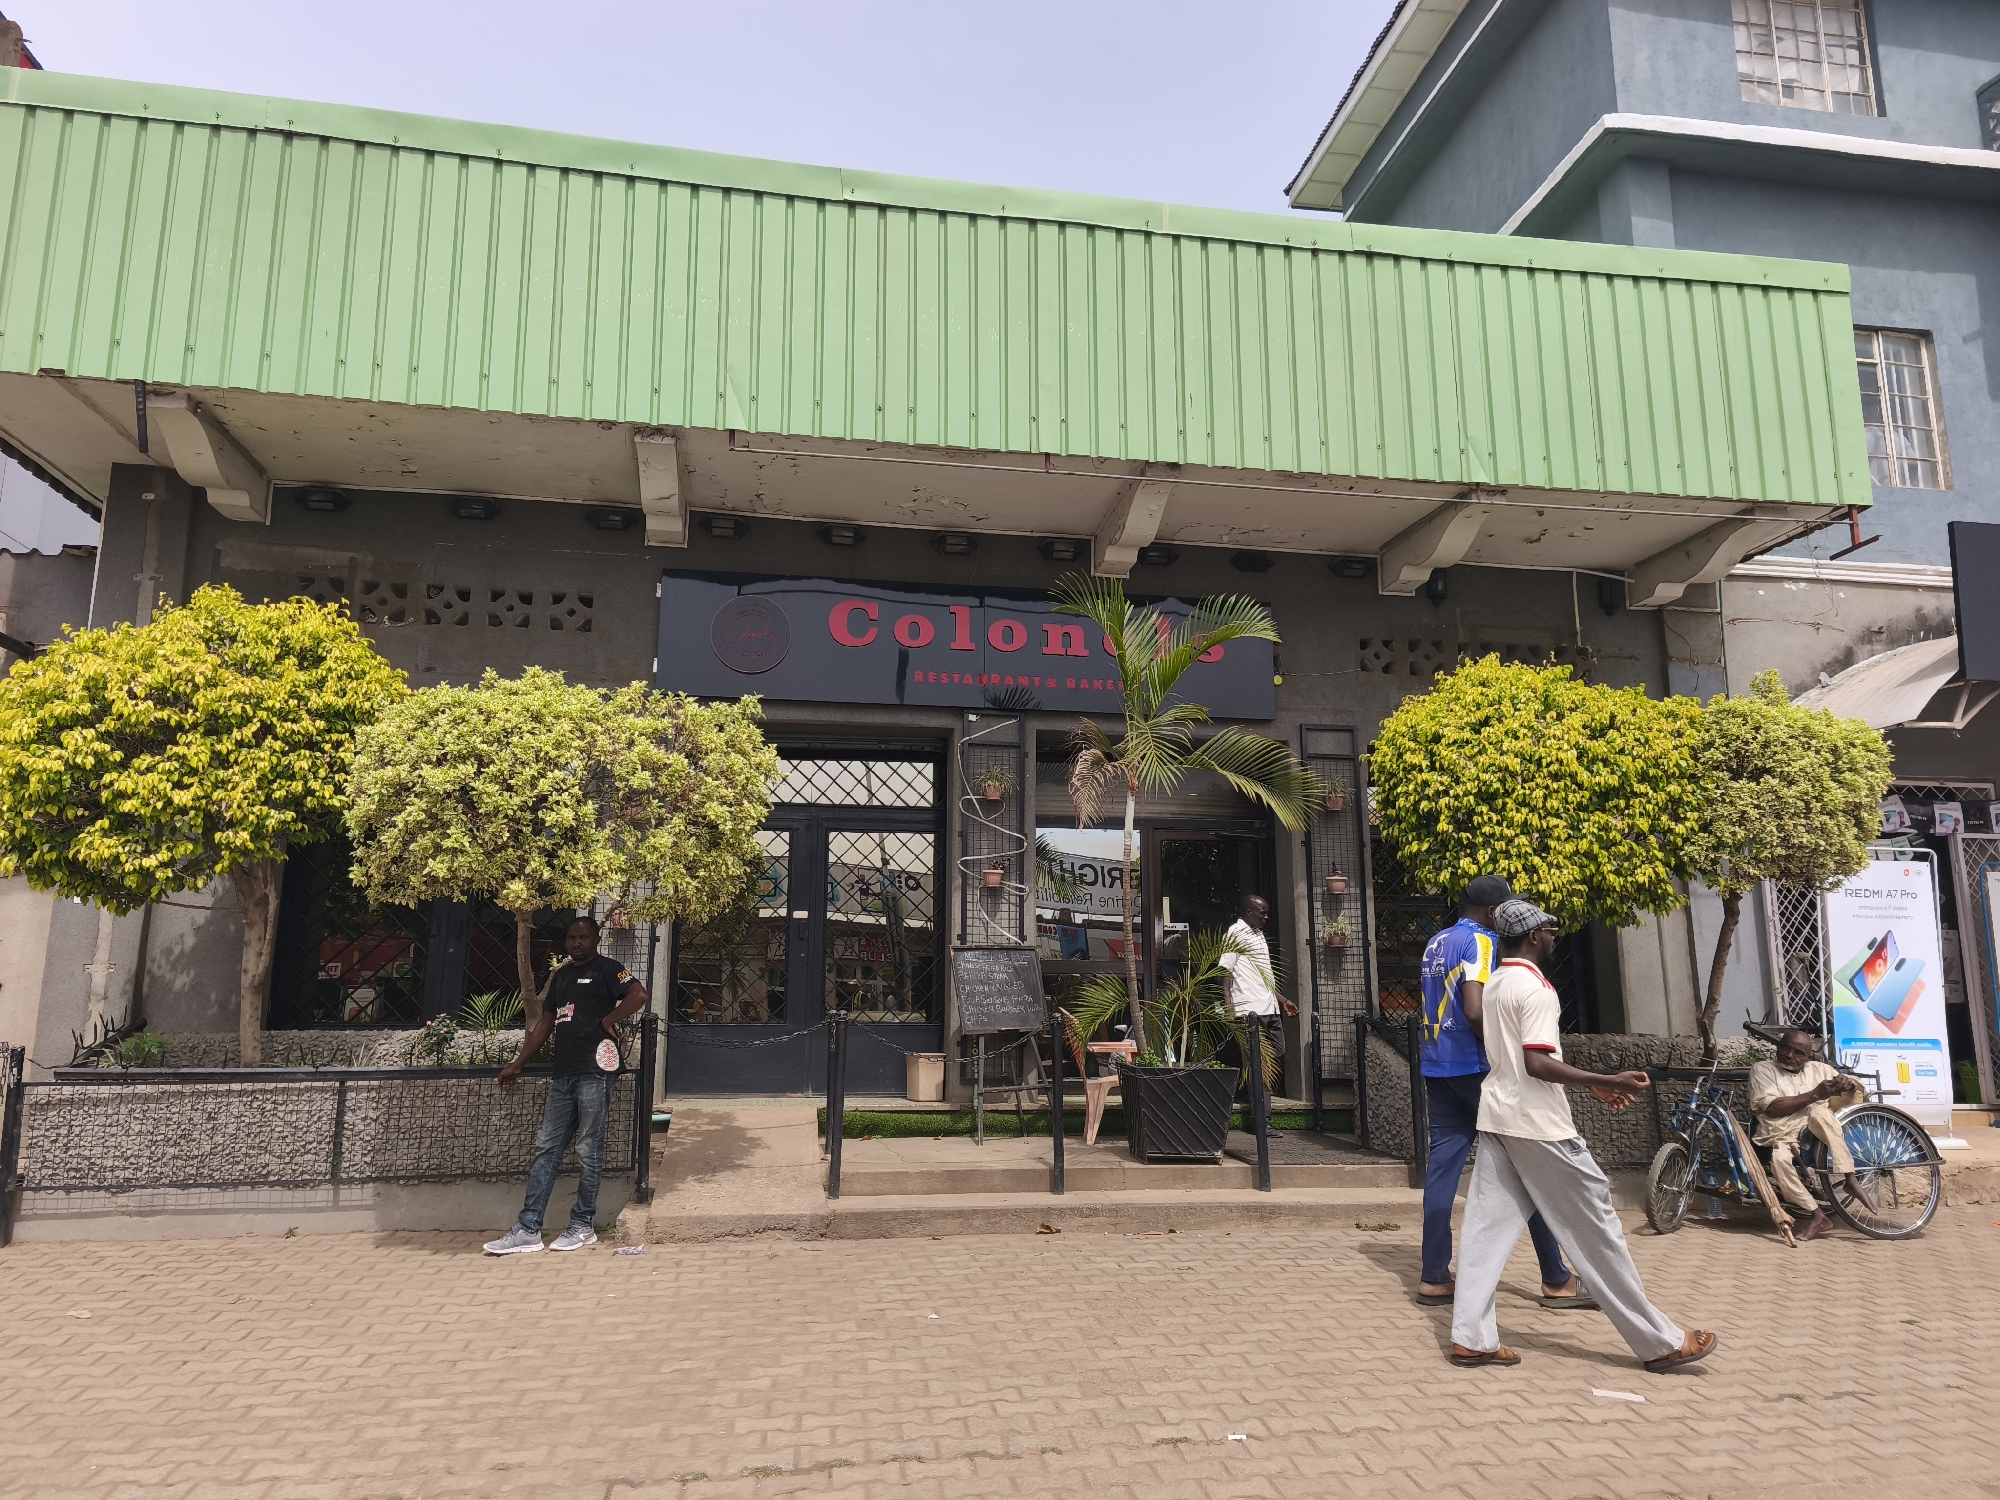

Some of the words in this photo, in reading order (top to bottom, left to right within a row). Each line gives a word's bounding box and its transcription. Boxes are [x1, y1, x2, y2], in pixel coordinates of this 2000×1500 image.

[1845, 888, 1883, 899] REDMI
[1885, 889, 1898, 899] A7
[1900, 889, 1918, 899] Pro
